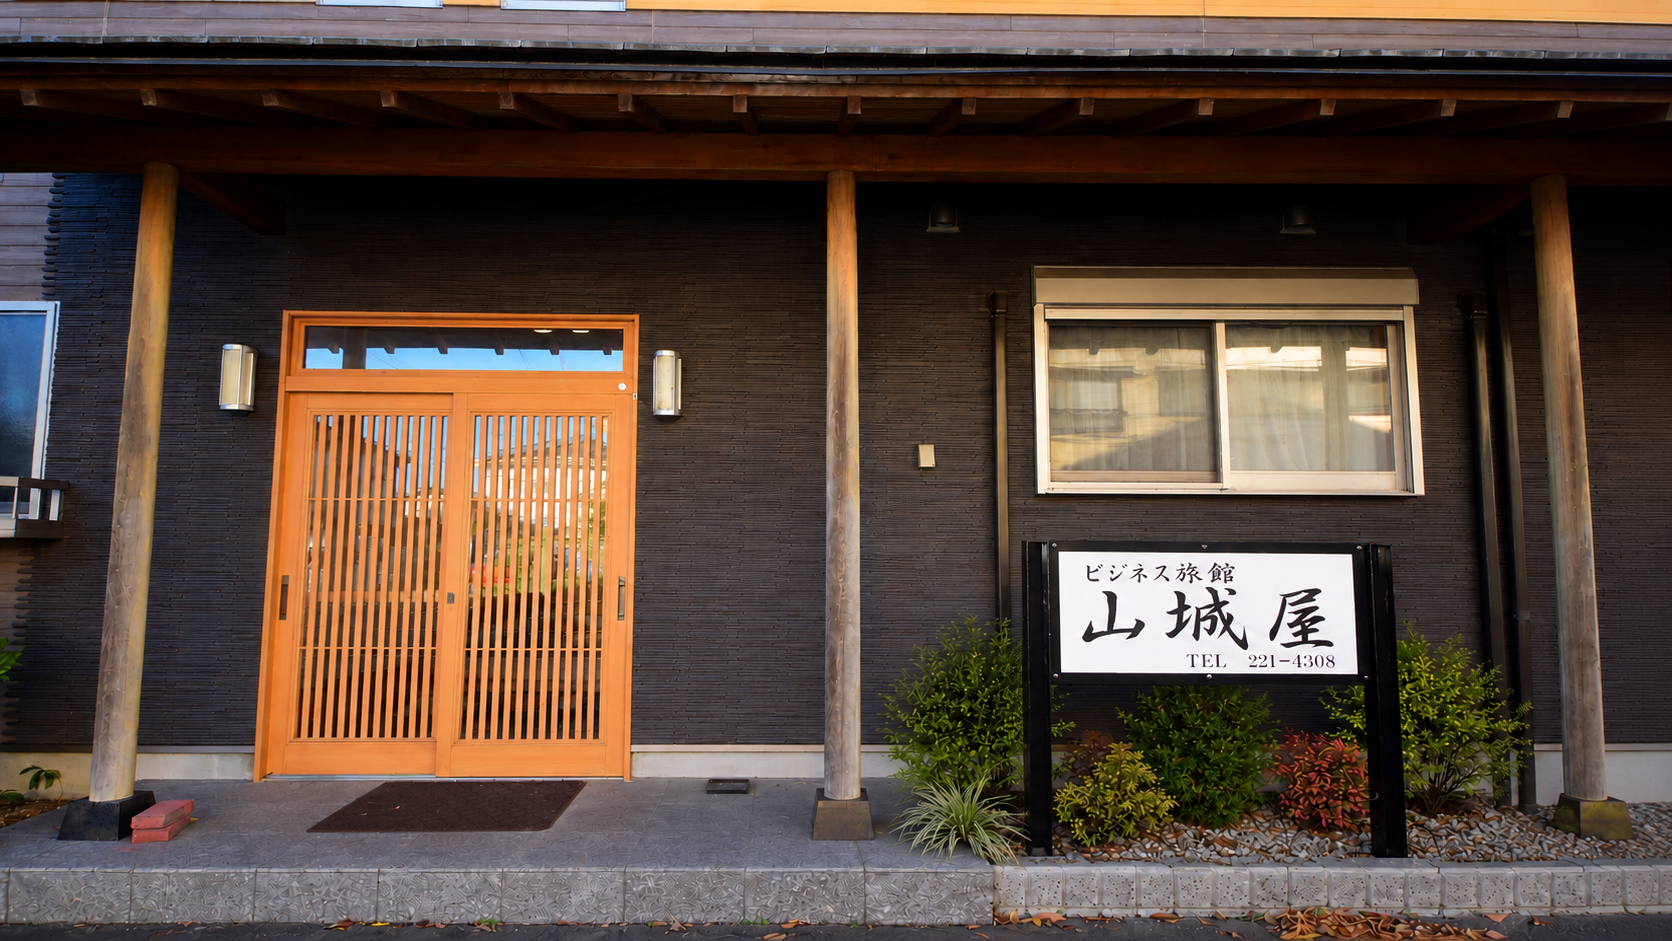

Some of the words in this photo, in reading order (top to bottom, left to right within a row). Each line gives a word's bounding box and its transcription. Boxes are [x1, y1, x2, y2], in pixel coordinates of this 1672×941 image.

[1086, 562, 1236, 583] ビジネス旅館
[1082, 586, 1334, 650] 山城屋
[1186, 653, 1227, 668] TEL
[1248, 653, 1336, 668] 221-4308
